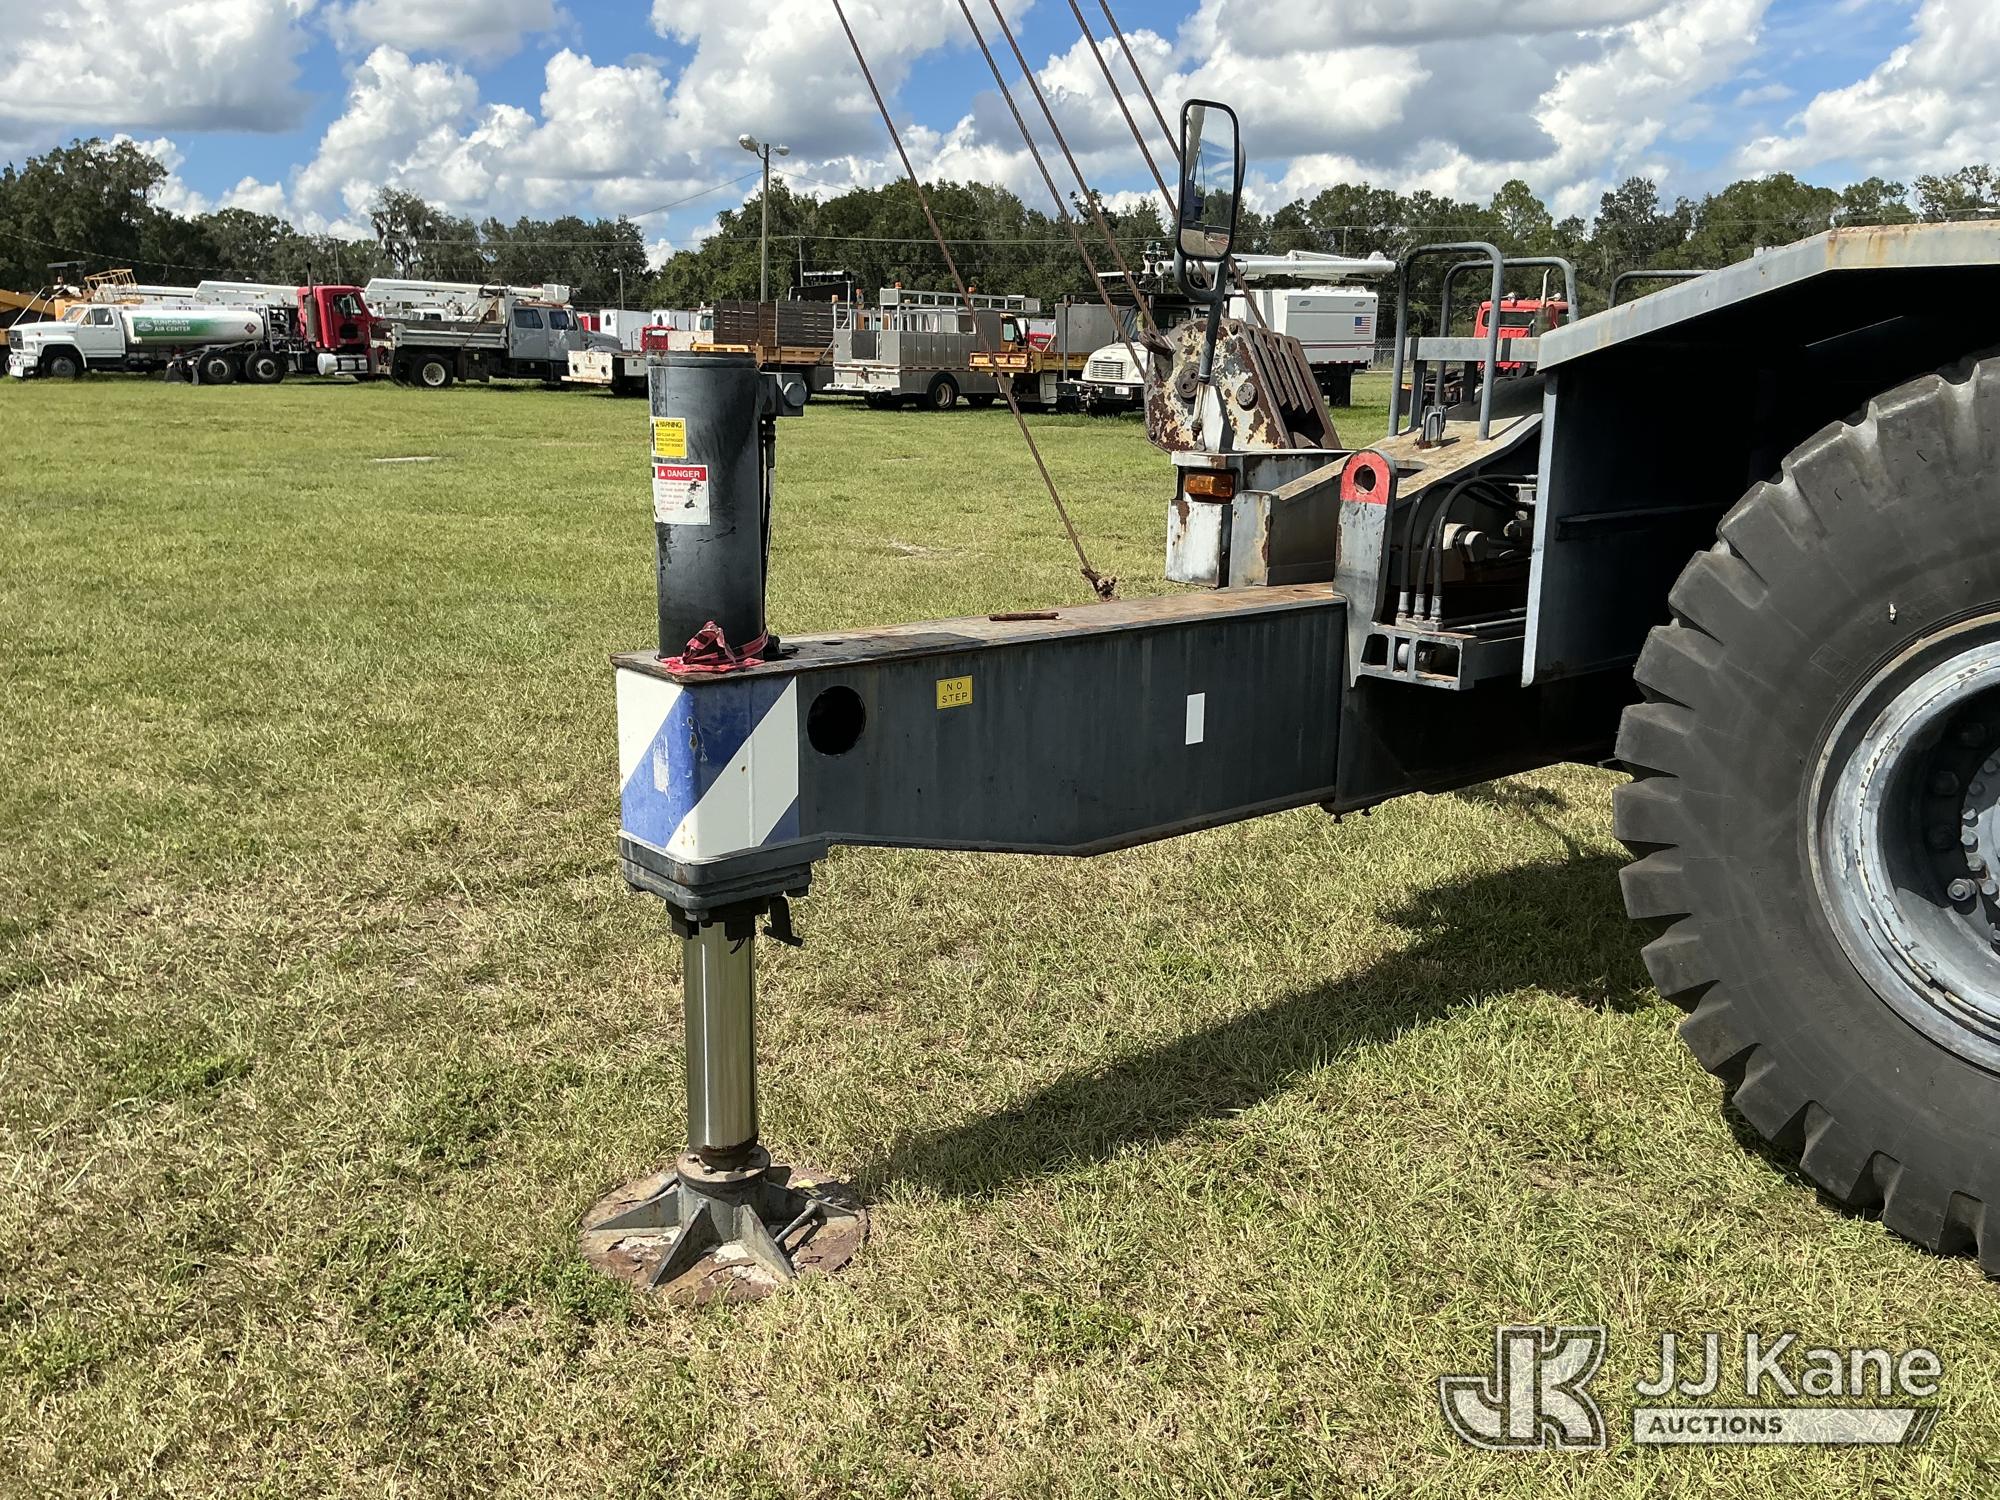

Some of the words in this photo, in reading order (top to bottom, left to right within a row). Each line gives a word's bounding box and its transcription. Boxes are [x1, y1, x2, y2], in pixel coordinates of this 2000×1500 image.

[667, 470, 700, 478] DANGER
[946, 682, 963, 691] NO
[942, 692, 967, 703] STEP
